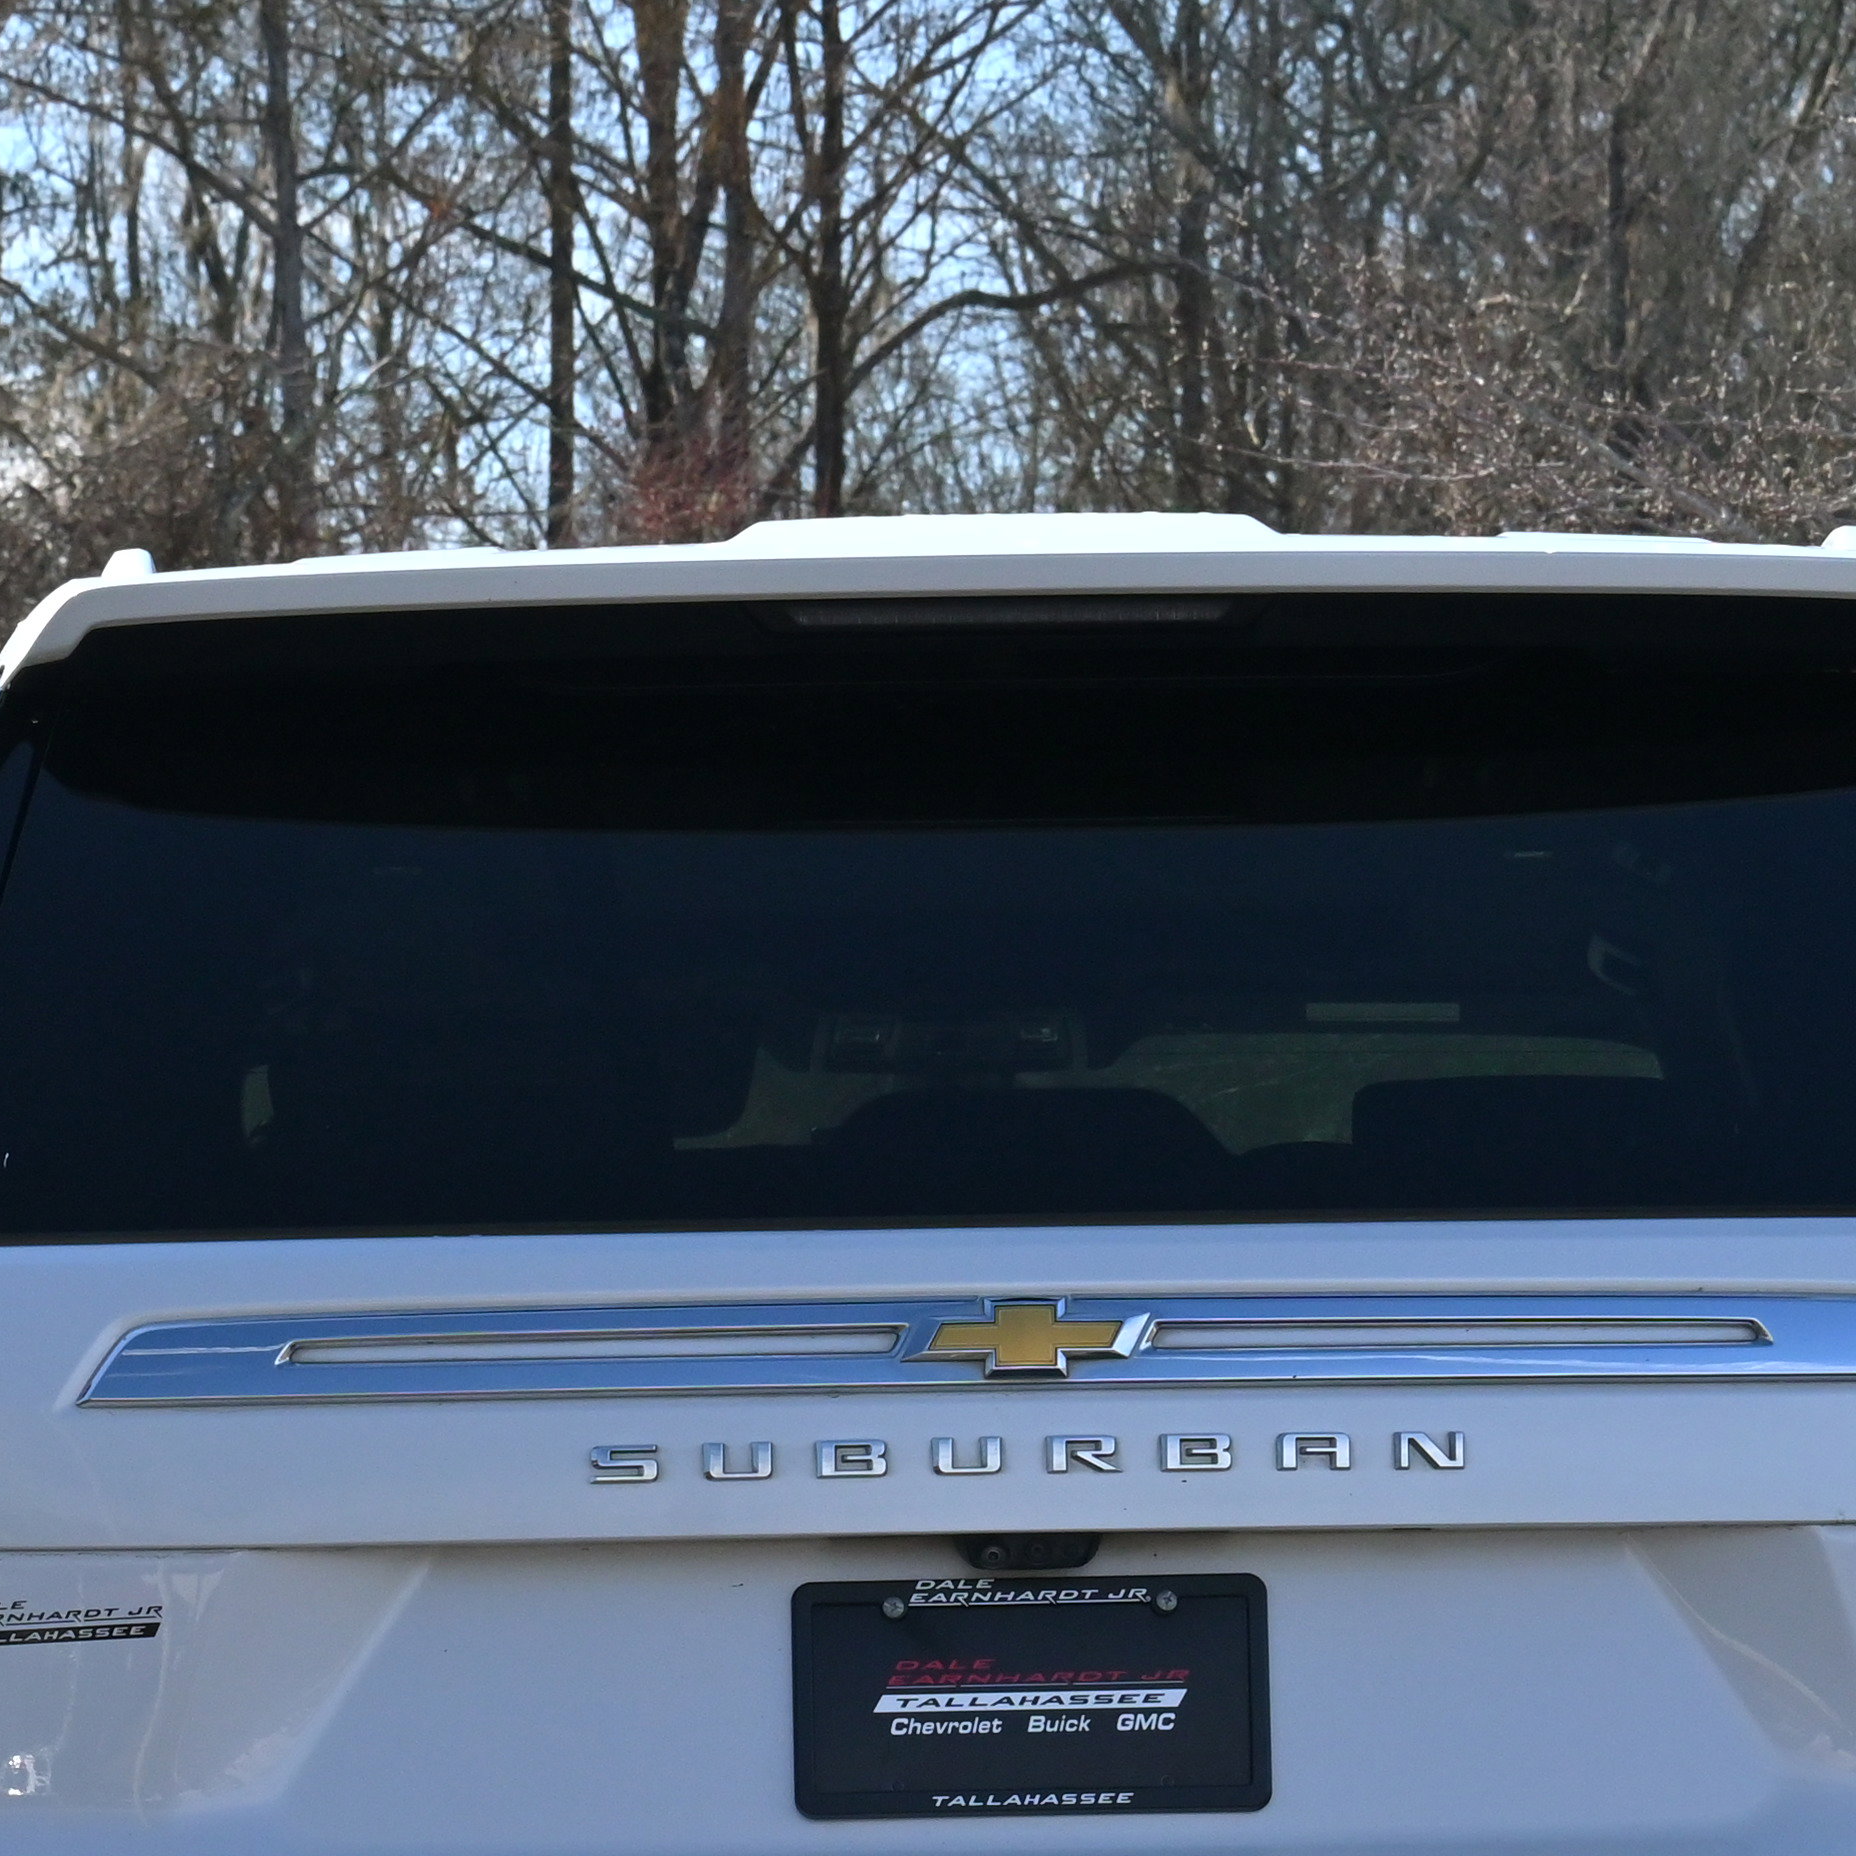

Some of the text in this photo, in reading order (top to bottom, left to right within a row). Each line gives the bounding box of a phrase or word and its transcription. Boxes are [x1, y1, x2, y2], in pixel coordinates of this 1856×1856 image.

[589, 1430, 1467, 1485] SUBURBAN
[914, 1578, 996, 1590] DALE
[908, 1588, 1100, 1606] EARNHARDT
[127, 1605, 164, 1619] JR
[894, 1658, 996, 1671] DALE
[886, 1669, 1191, 1687] EARNHARDT JR
[895, 1692, 1166, 1709] TALLAHASSEE
[890, 1712, 1177, 1736] Chevrolet Buick GMC
[932, 1791, 1135, 1807] TALLAHASSEE
